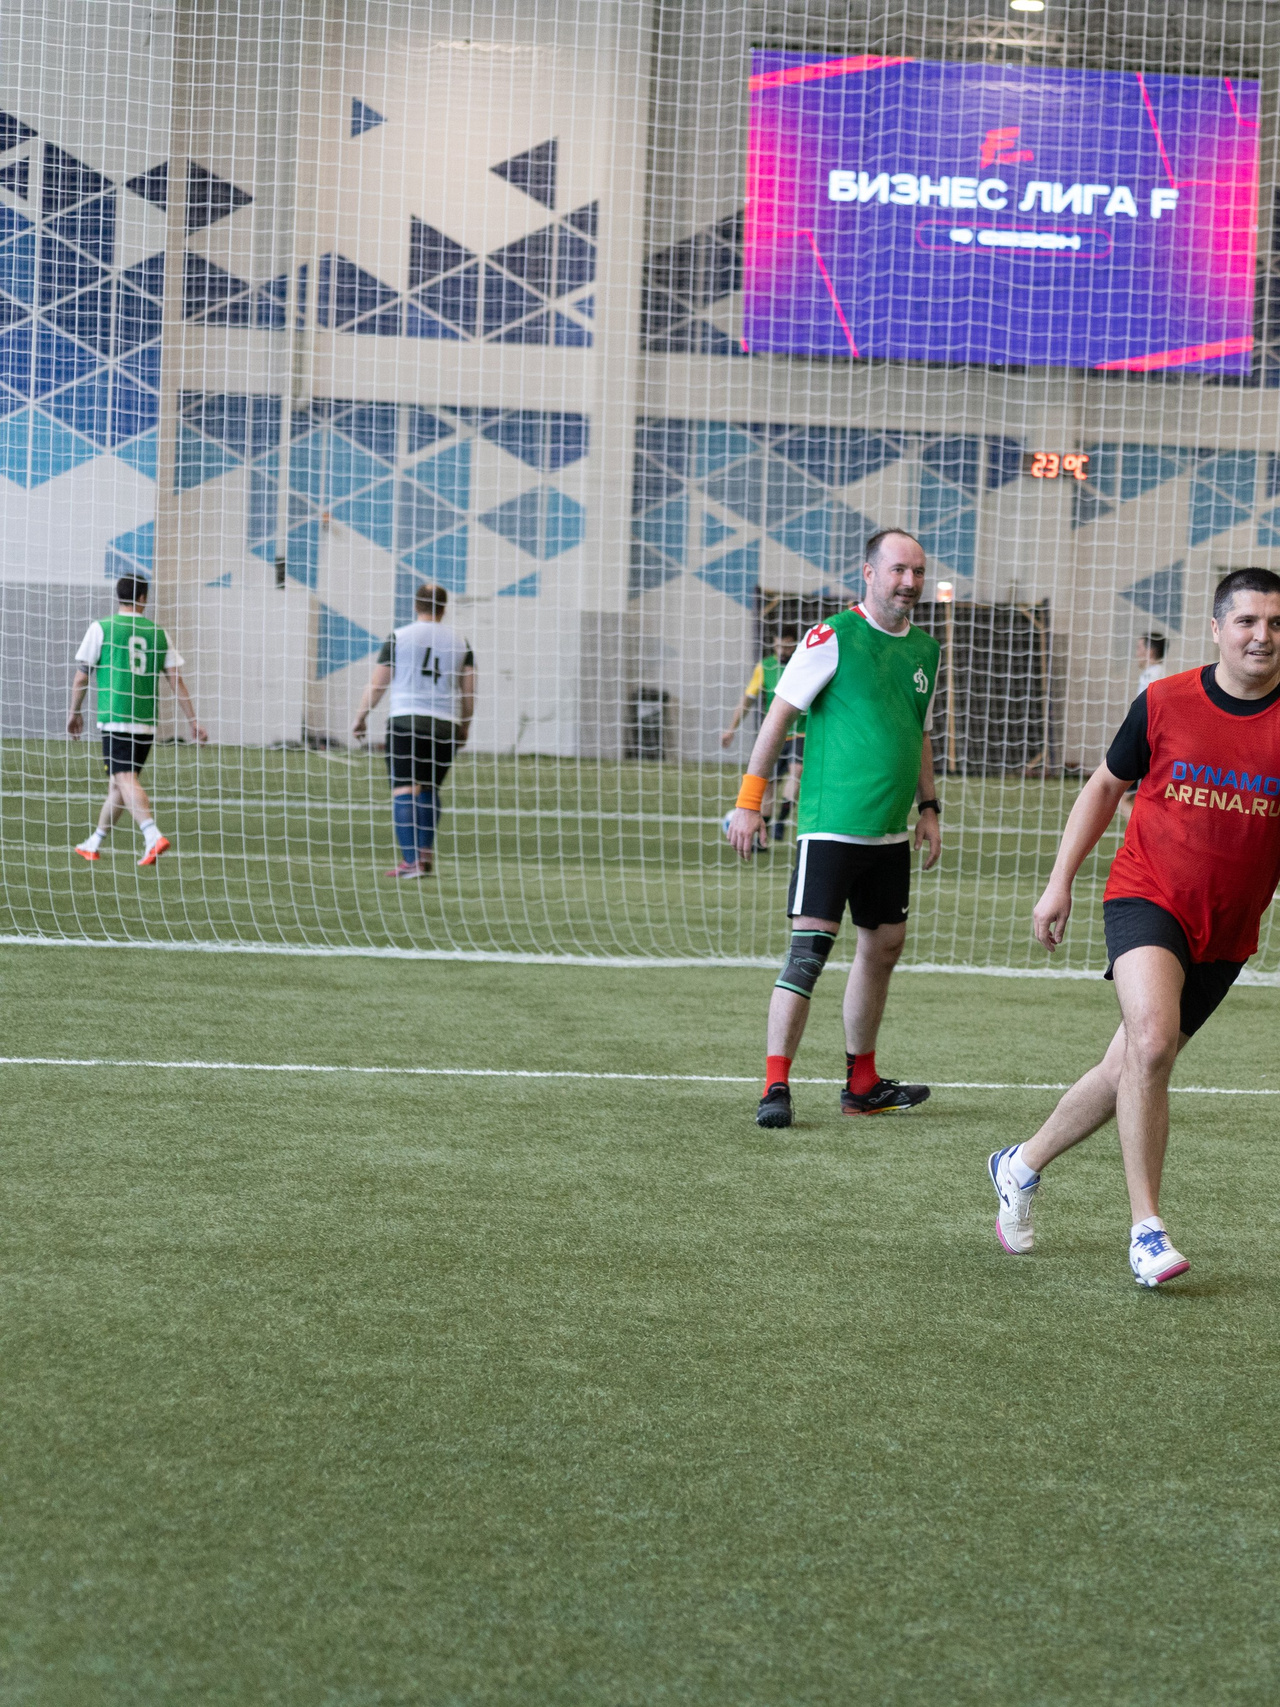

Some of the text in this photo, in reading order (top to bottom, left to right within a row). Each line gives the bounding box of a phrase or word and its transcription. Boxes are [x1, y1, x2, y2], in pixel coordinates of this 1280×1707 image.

[828, 169, 1008, 210] БИЗНЕС
[1018, 181, 1138, 217] ЛИГА
[129, 636, 147, 676] 6
[422, 647, 441, 685] 4
[1172, 761, 1280, 796] DYNAMO
